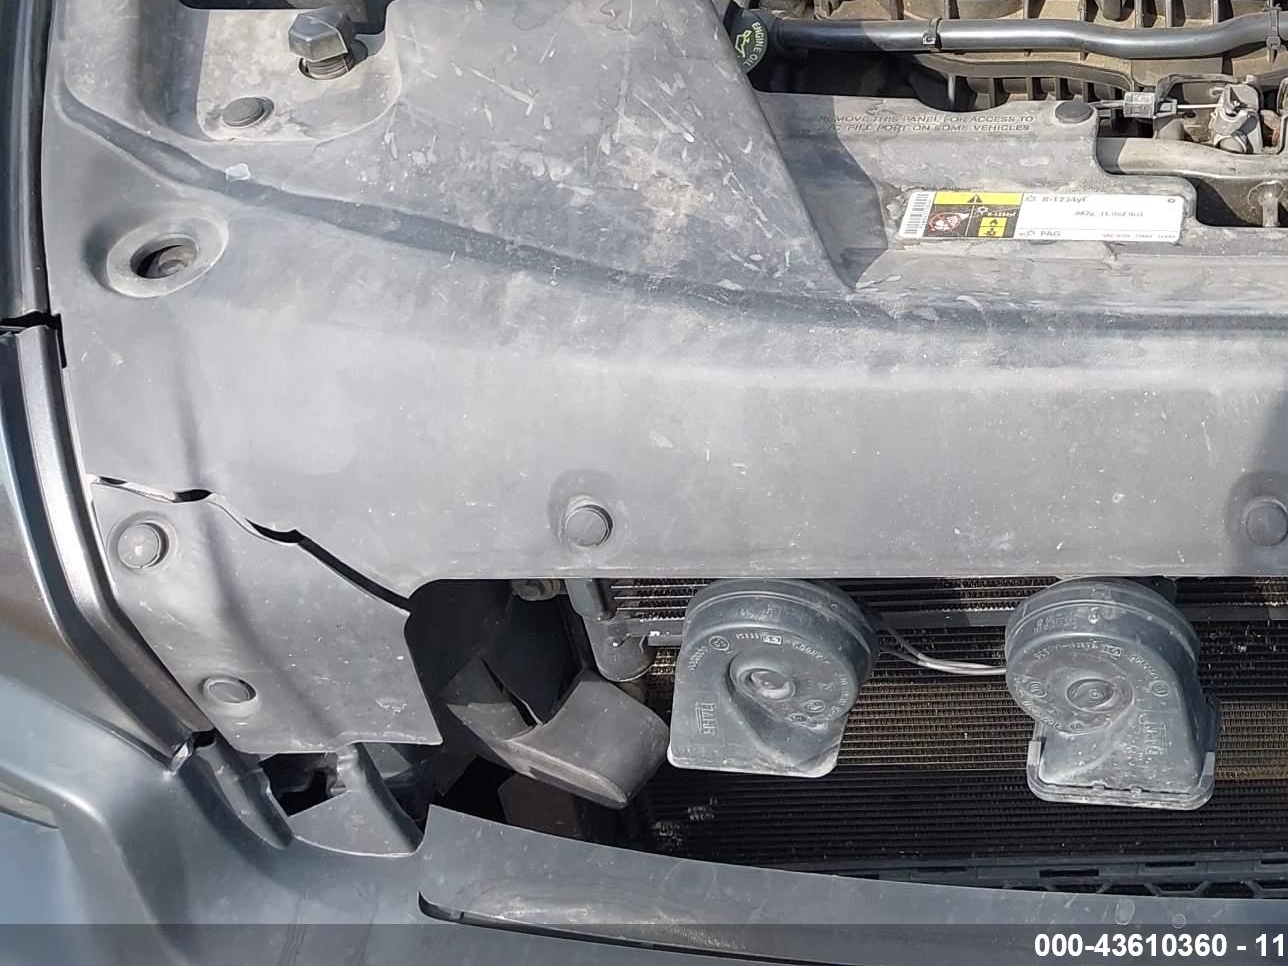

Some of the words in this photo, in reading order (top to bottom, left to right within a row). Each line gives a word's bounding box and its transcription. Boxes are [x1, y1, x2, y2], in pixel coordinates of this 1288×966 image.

[752, 22, 764, 53] ENGINE
[742, 54, 758, 67] OIL
[1019, 115, 1034, 123] TO
[911, 124, 931, 132] ON
[973, 124, 1030, 132] VEHICLES
[1040, 230, 1061, 238] PAG
